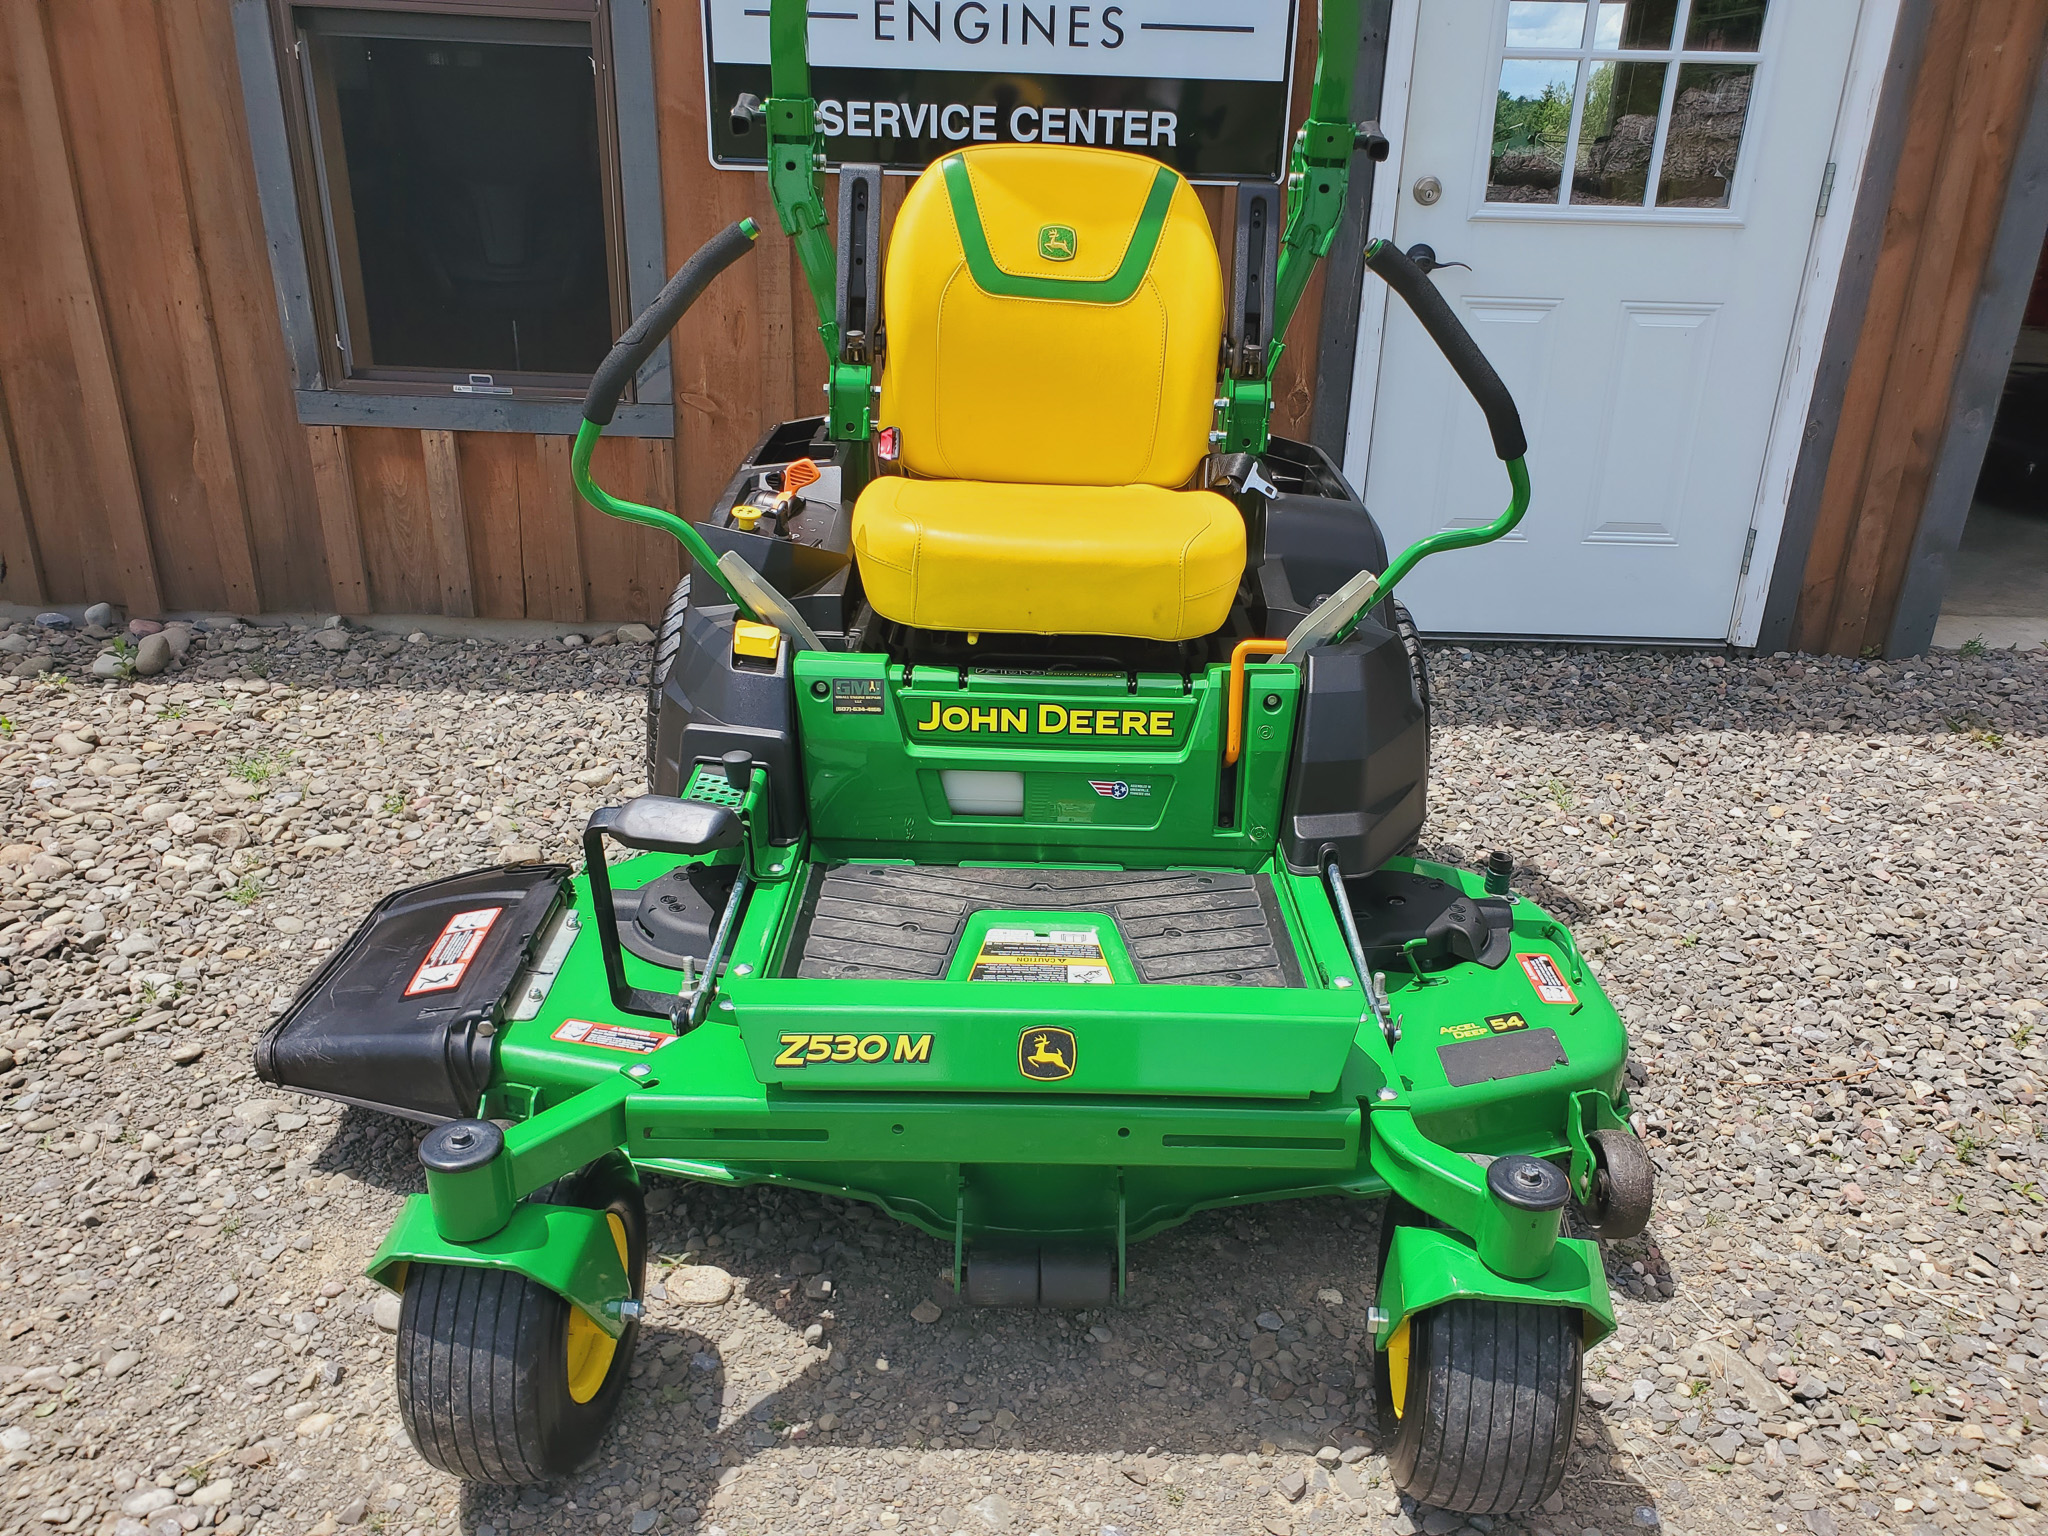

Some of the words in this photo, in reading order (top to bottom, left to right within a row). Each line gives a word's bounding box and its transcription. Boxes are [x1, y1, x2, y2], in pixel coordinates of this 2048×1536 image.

[874, 0, 1125, 49] ENGINES
[819, 99, 997, 141] SERVICE
[1010, 105, 1177, 147] CENTER
[917, 700, 1028, 734] JOHN
[1038, 704, 1176, 737] DEERE
[1440, 1023, 1480, 1035] ACCEL
[1453, 1028, 1488, 1039] DEEP
[1489, 1015, 1525, 1031] 54
[775, 1033, 891, 1068] Z530
[893, 1034, 935, 1063] M
